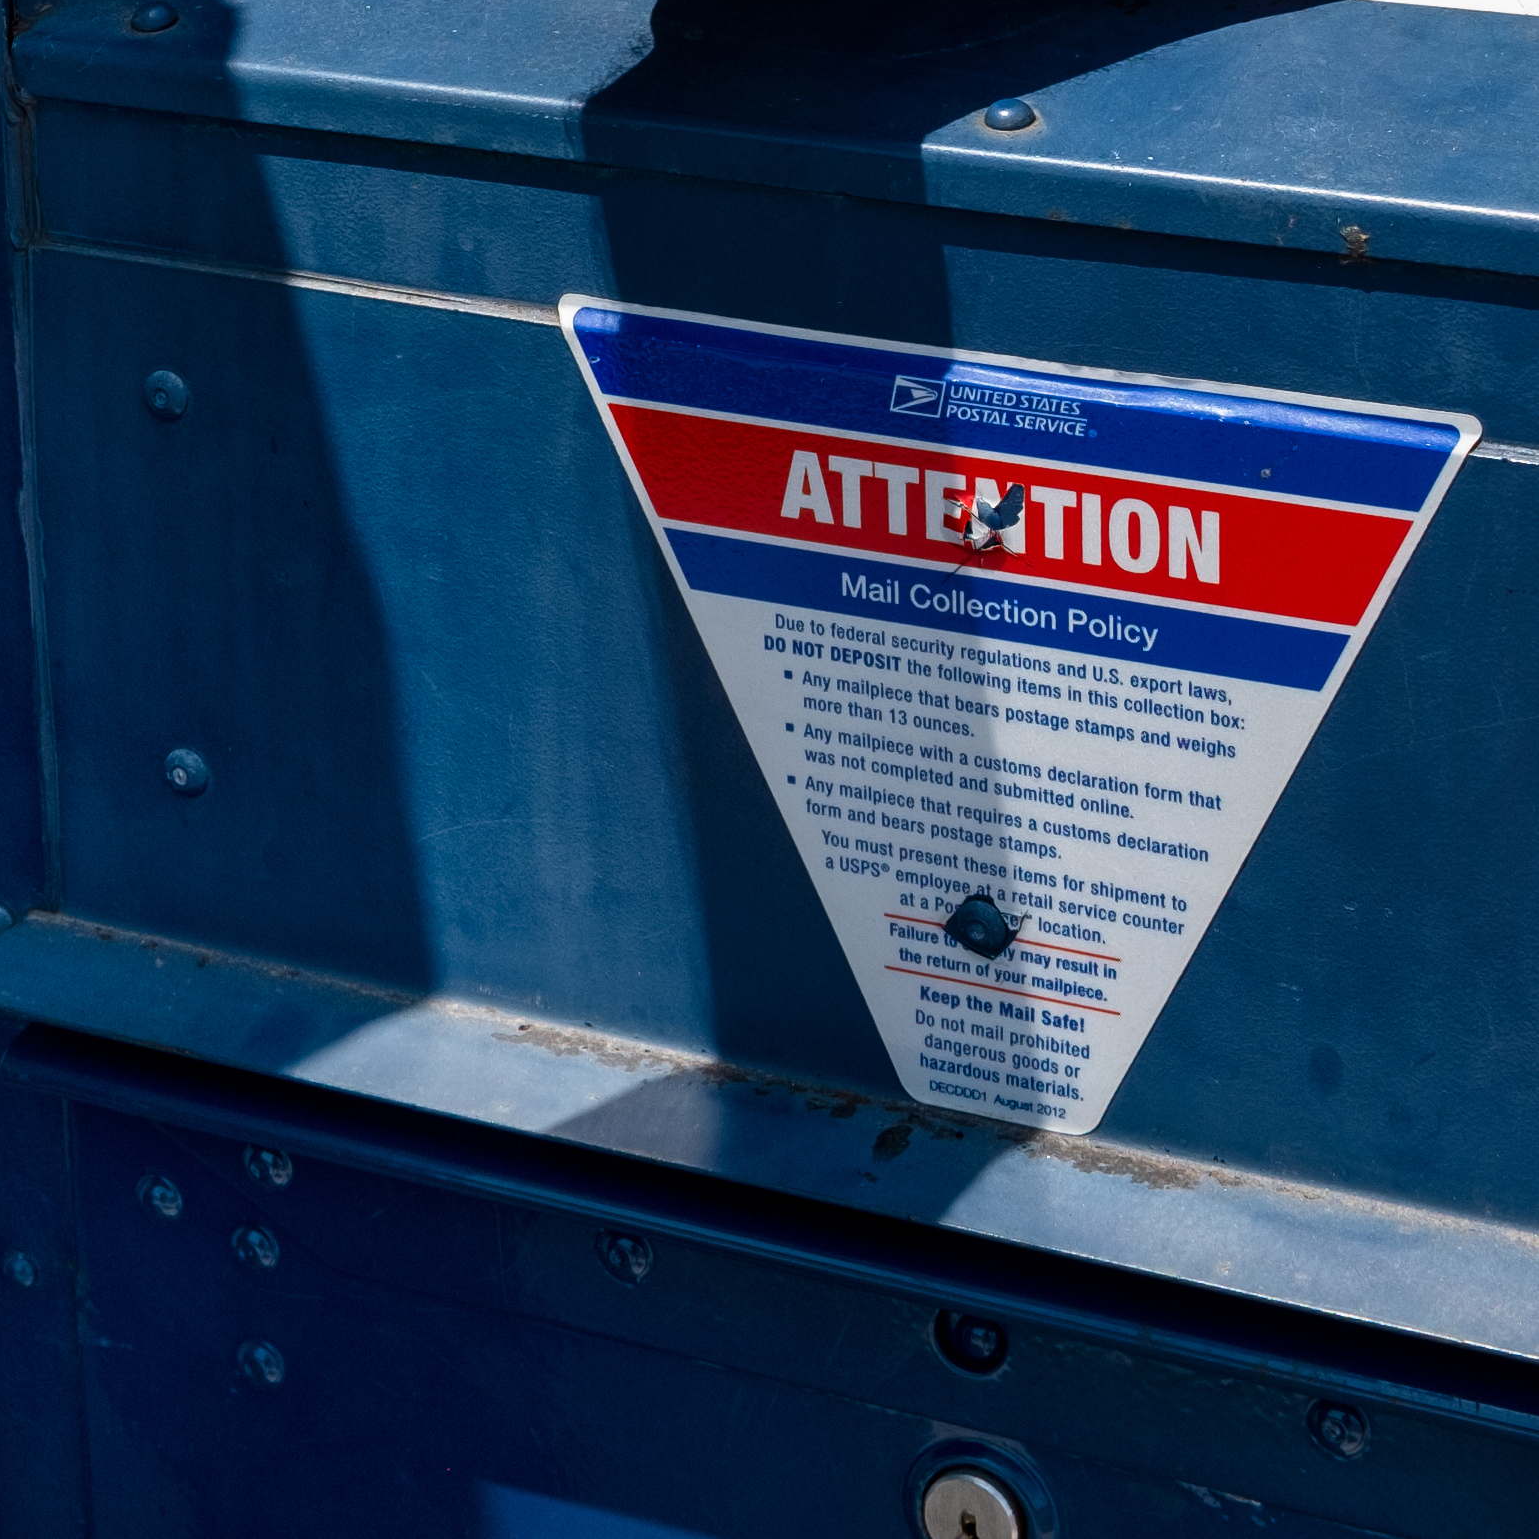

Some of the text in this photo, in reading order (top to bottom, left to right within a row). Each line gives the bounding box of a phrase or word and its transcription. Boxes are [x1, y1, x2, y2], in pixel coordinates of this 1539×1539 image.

[946, 404, 1010, 426] POSTAL
[949, 385, 1081, 416] UNITED STATES
[779, 449, 1220, 586] ATTENTION
[841, 572, 1159, 652] Mail Collection Policy
[764, 634, 1244, 730] DO NOT DEPOSIT the following items in this collection box:
[776, 614, 1232, 706] Due to federal security regulations and U.S. export laws,
[802, 671, 1236, 758] Any mailpiece that bears postage stamps and weighs
[804, 697, 974, 737] more than 13 ounces.
[804, 723, 1221, 810] Any mailpiece with a customs declaration form that
[805, 750, 1134, 818] was not completed and submitted online.
[806, 776, 1208, 862] Any mailpiece that requires a customs declaration
[806, 798, 1061, 859] form and bears postage stamps.
[822, 830, 1186, 912] You must present these items for shipment to
[826, 856, 1184, 935] a USPS® employee at a retail service counter
[899, 892, 915, 907] at
[920, 897, 929, 910] a
[935, 897, 960, 914] Pos
[1039, 917, 1106, 944] location.
[890, 922, 939, 945] Failure
[944, 933, 958, 947] to
[1020, 951, 1051, 969] may
[1056, 958, 1098, 976] result
[1104, 964, 1116, 980] in
[899, 948, 1107, 1001] the return of your mailpiece.
[916, 1009, 1090, 1059] Do not mail prohibited
[920, 985, 1084, 1033] Keep the Mail Safe!
[920, 1052, 1084, 1101] hazardous materials.
[924, 1034, 1080, 1078] dangerous goods or
[994, 1094, 1033, 1112] August
[1037, 1103, 1066, 1119] 2012
